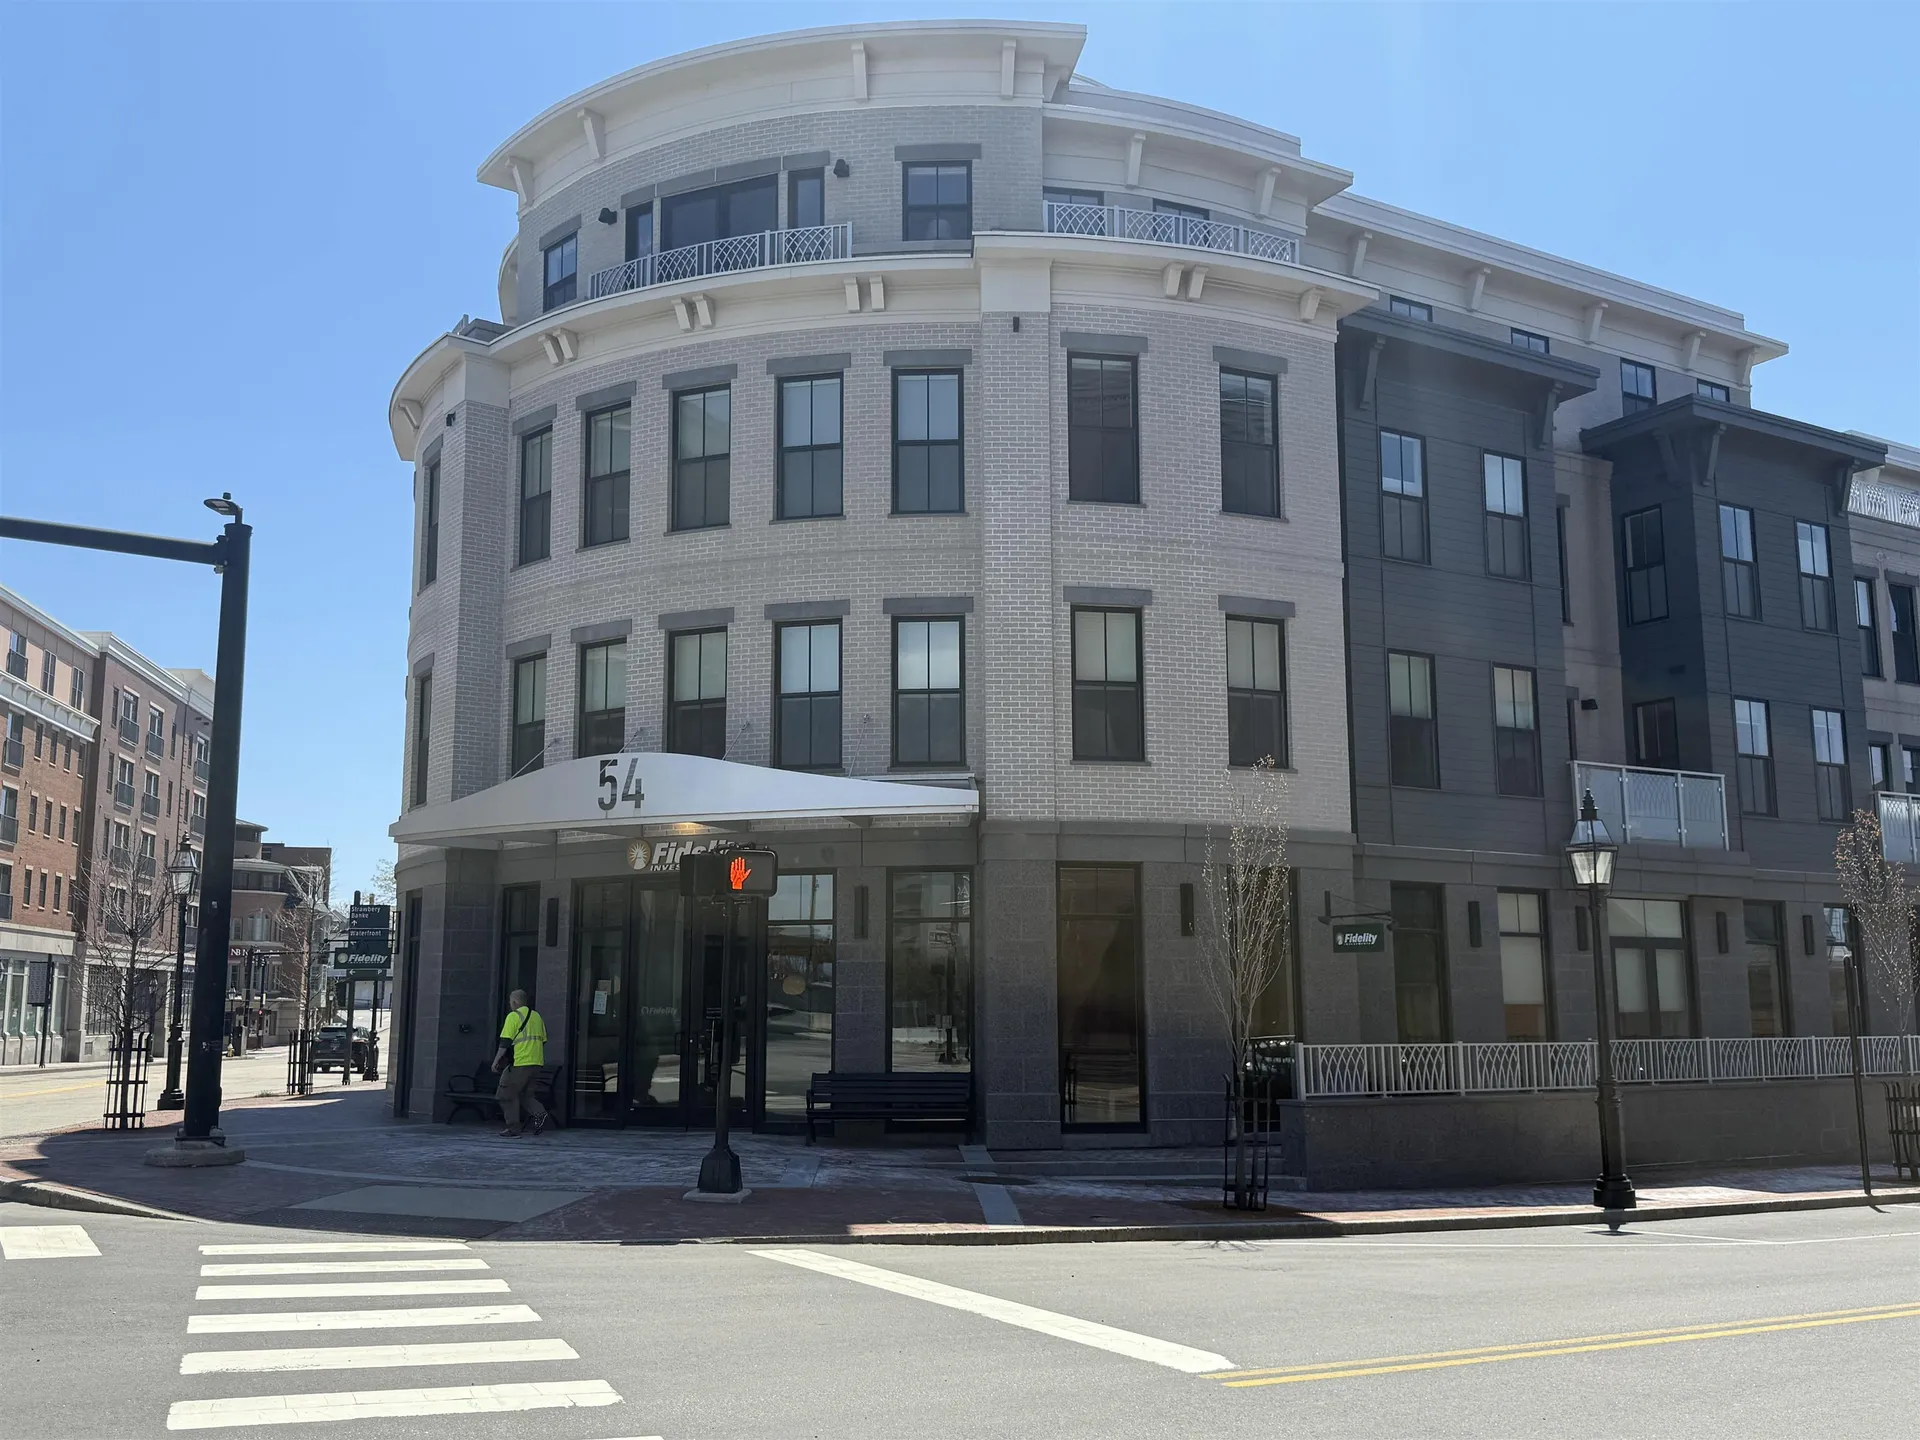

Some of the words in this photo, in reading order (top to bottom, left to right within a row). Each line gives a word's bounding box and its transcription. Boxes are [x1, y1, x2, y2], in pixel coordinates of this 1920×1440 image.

[598, 758, 645, 811] 54
[1344, 932, 1378, 945] Fidelity
[348, 954, 388, 964] Fidelity
[649, 1006, 678, 1016] Fidelity
